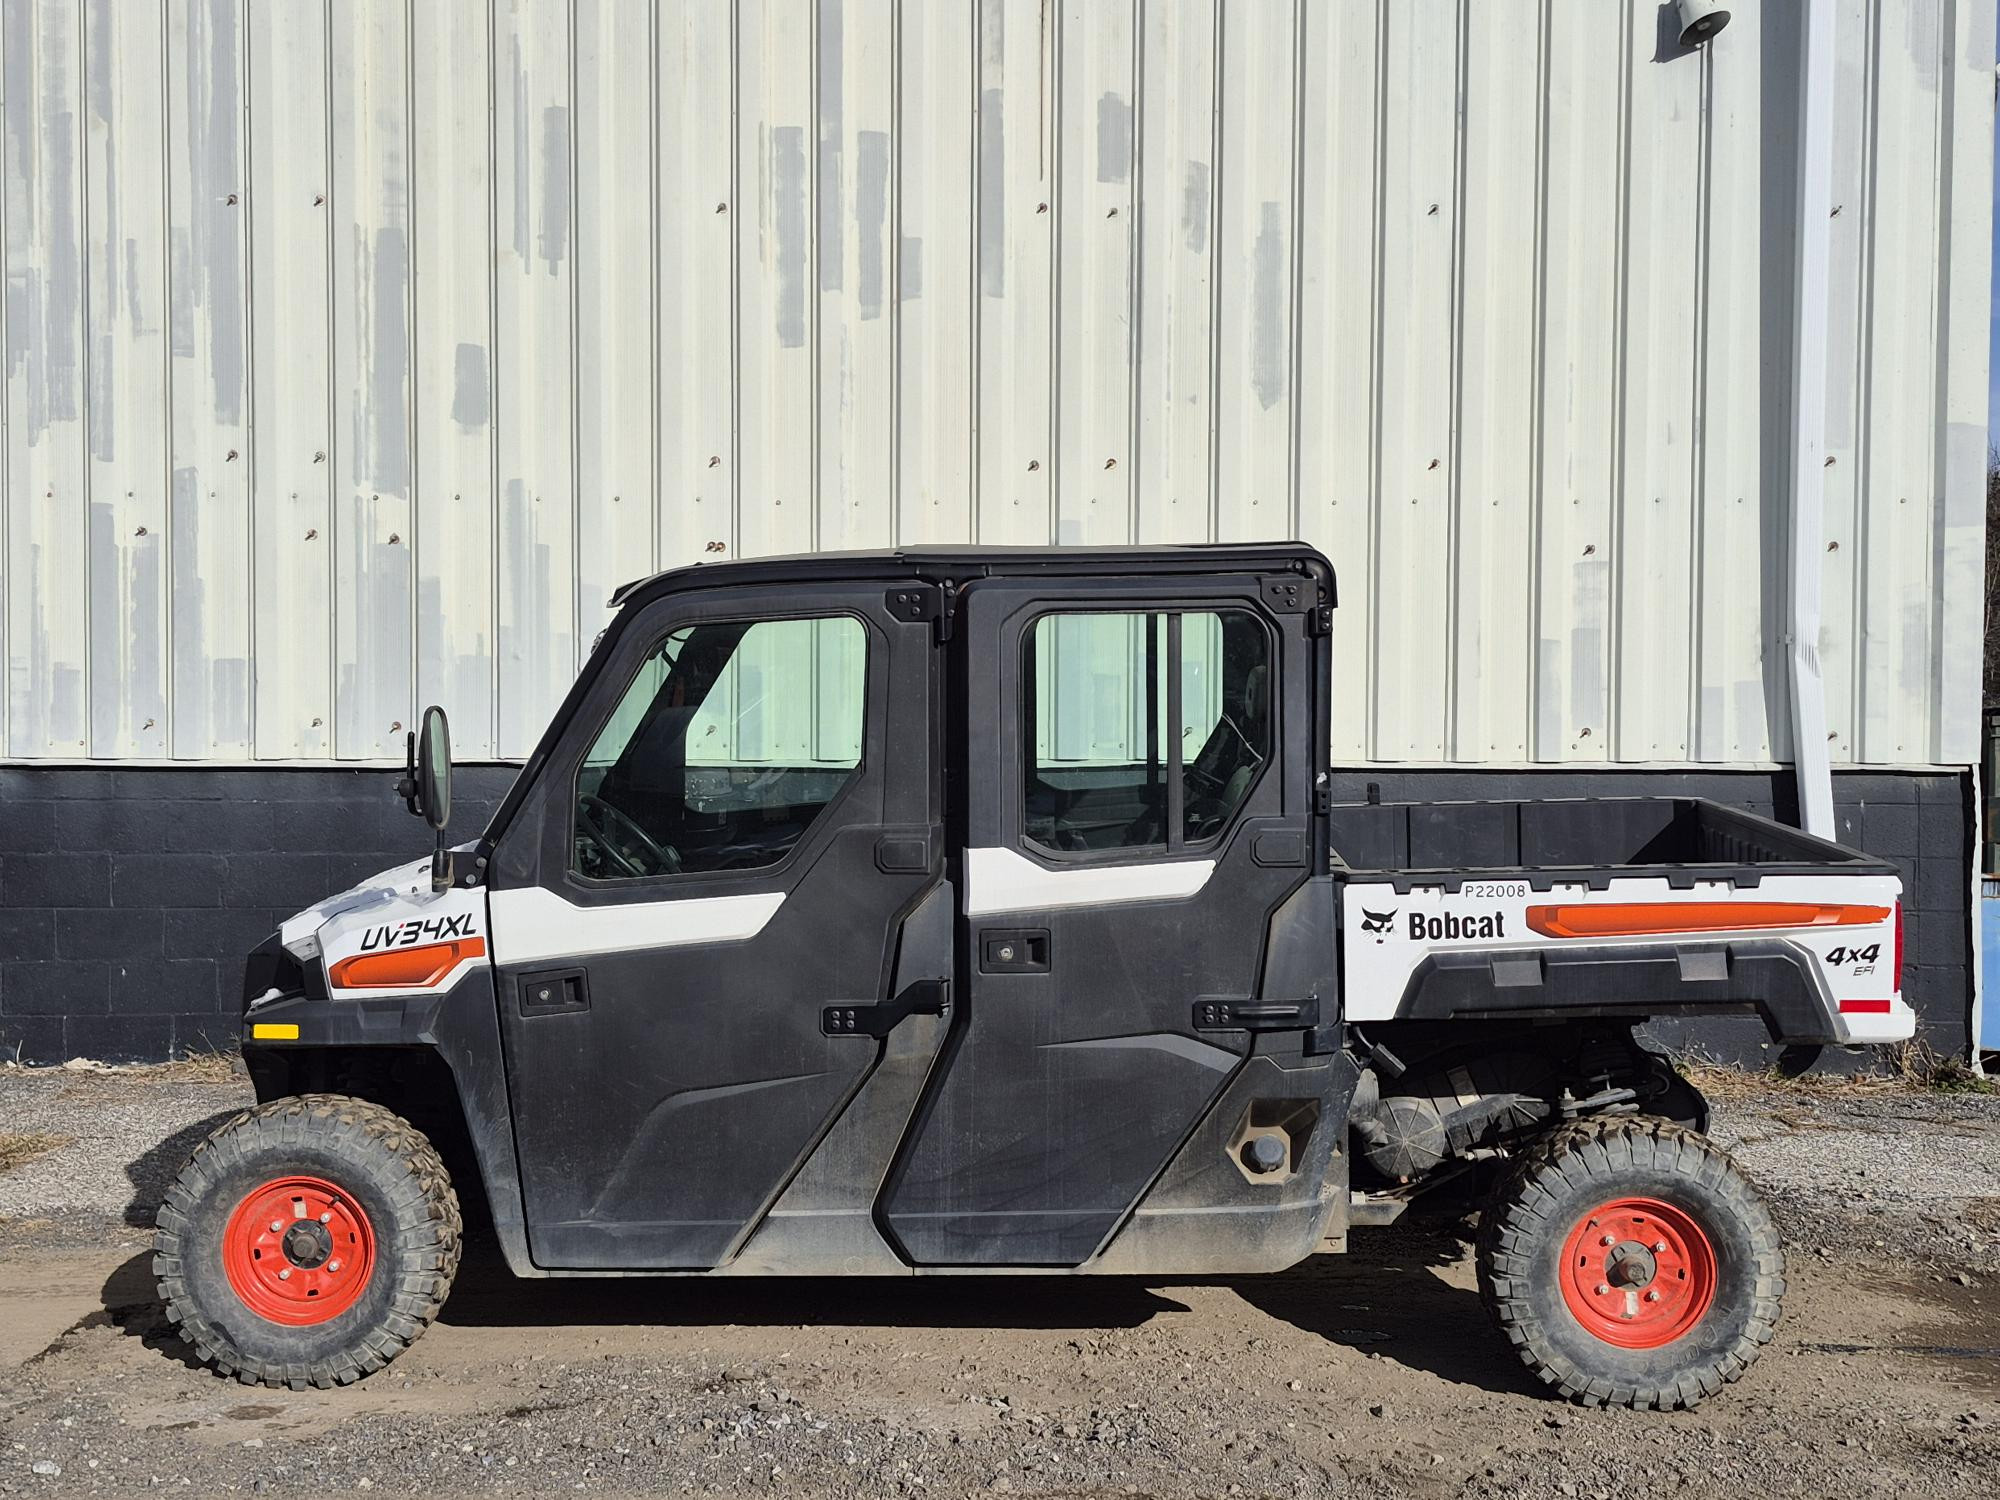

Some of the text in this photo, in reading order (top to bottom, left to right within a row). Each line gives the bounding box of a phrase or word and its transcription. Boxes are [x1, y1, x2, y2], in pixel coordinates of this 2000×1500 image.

[1465, 885, 1526, 898] P22008
[360, 913, 477, 951] UV34XL
[1408, 911, 1505, 941] Bobcat
[1825, 943, 1881, 967] 4x4
[1852, 965, 1876, 977] EFI
